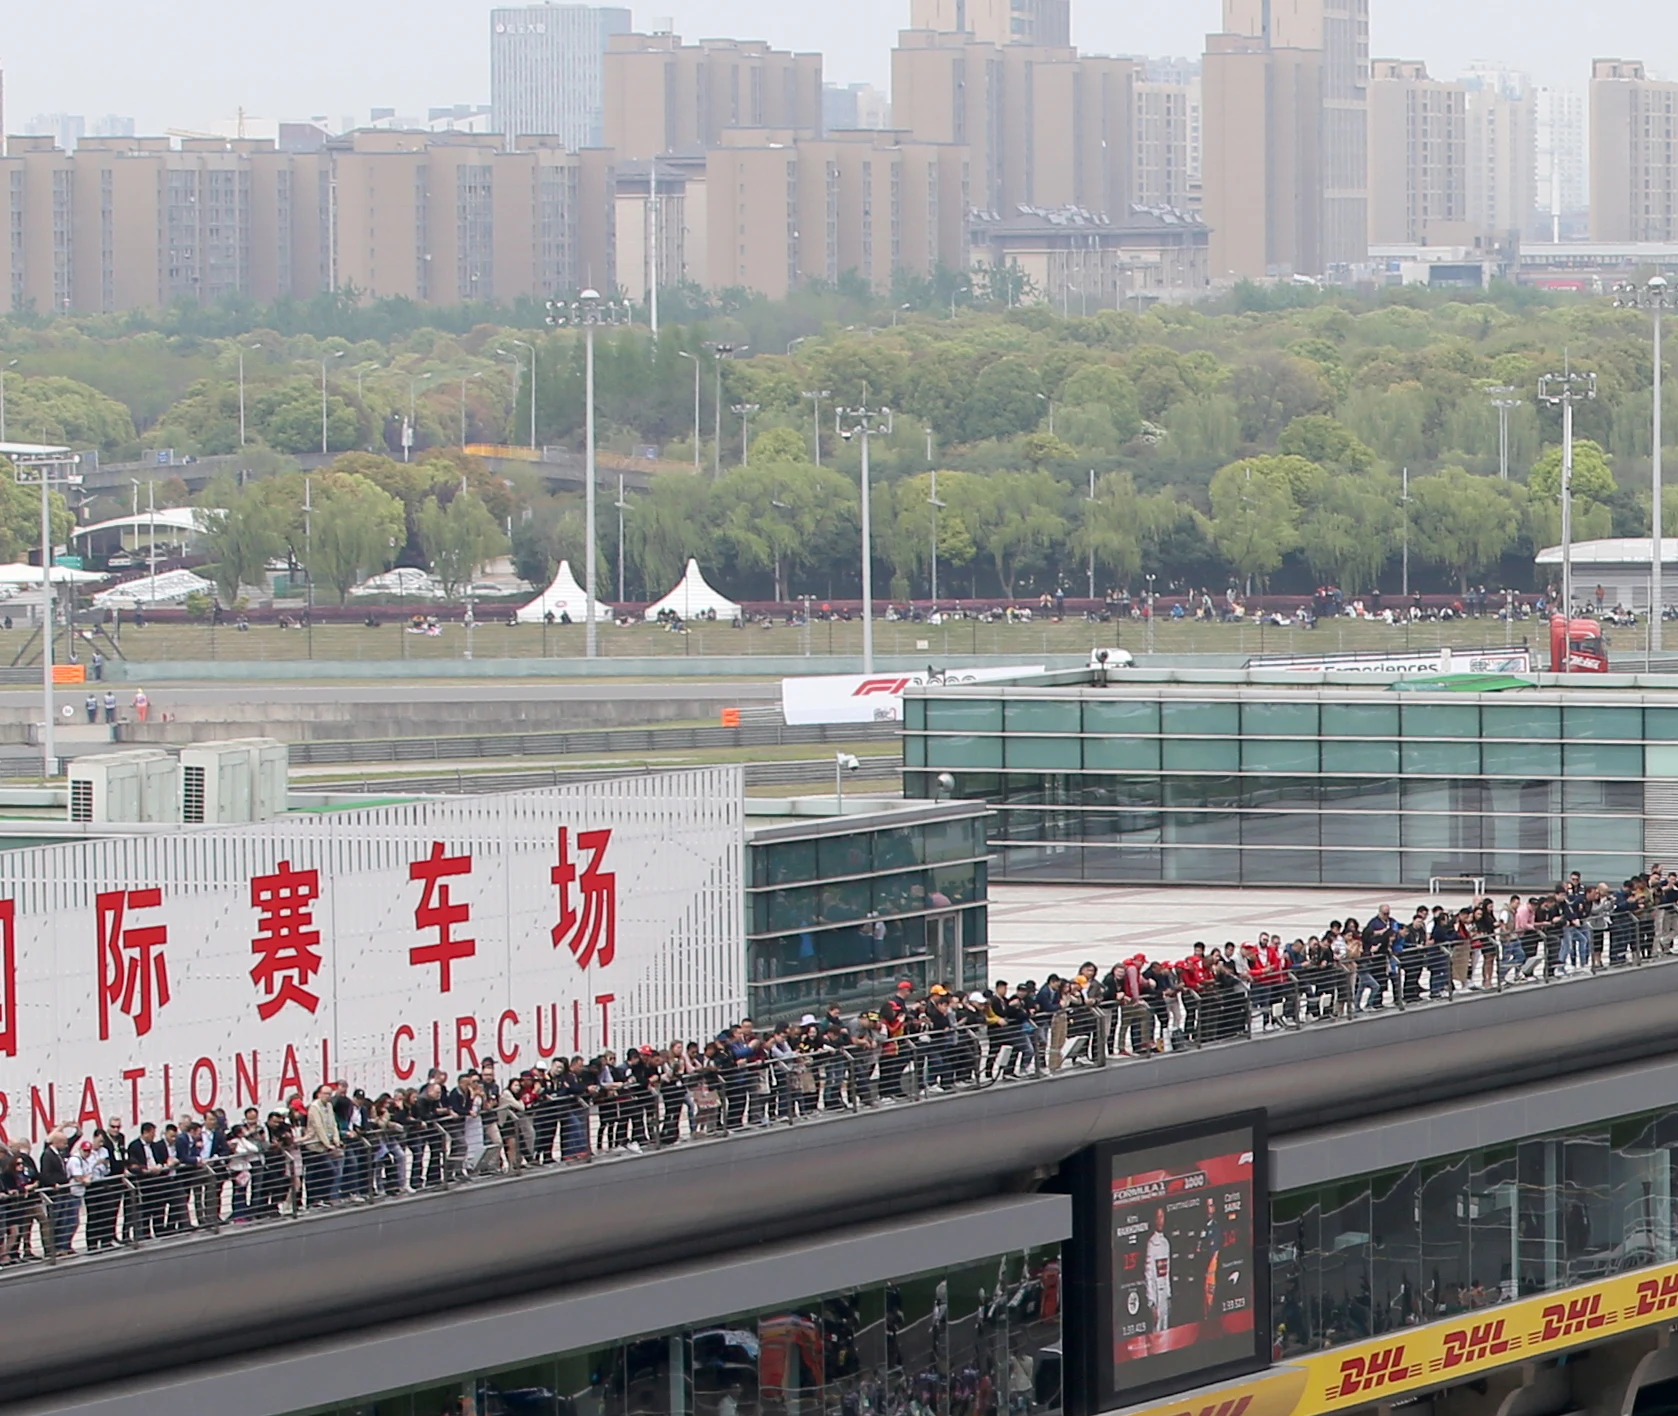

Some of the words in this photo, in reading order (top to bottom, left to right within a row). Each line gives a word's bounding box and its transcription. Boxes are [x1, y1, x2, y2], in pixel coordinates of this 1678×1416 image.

[0, 826, 616, 1057] 际赛车场
[392, 993, 615, 1080] CIRCUIT
[1541, 1293, 1606, 1341] DHL
[1443, 1319, 1511, 1370] DHL
[1339, 1345, 1410, 1397] DHL
